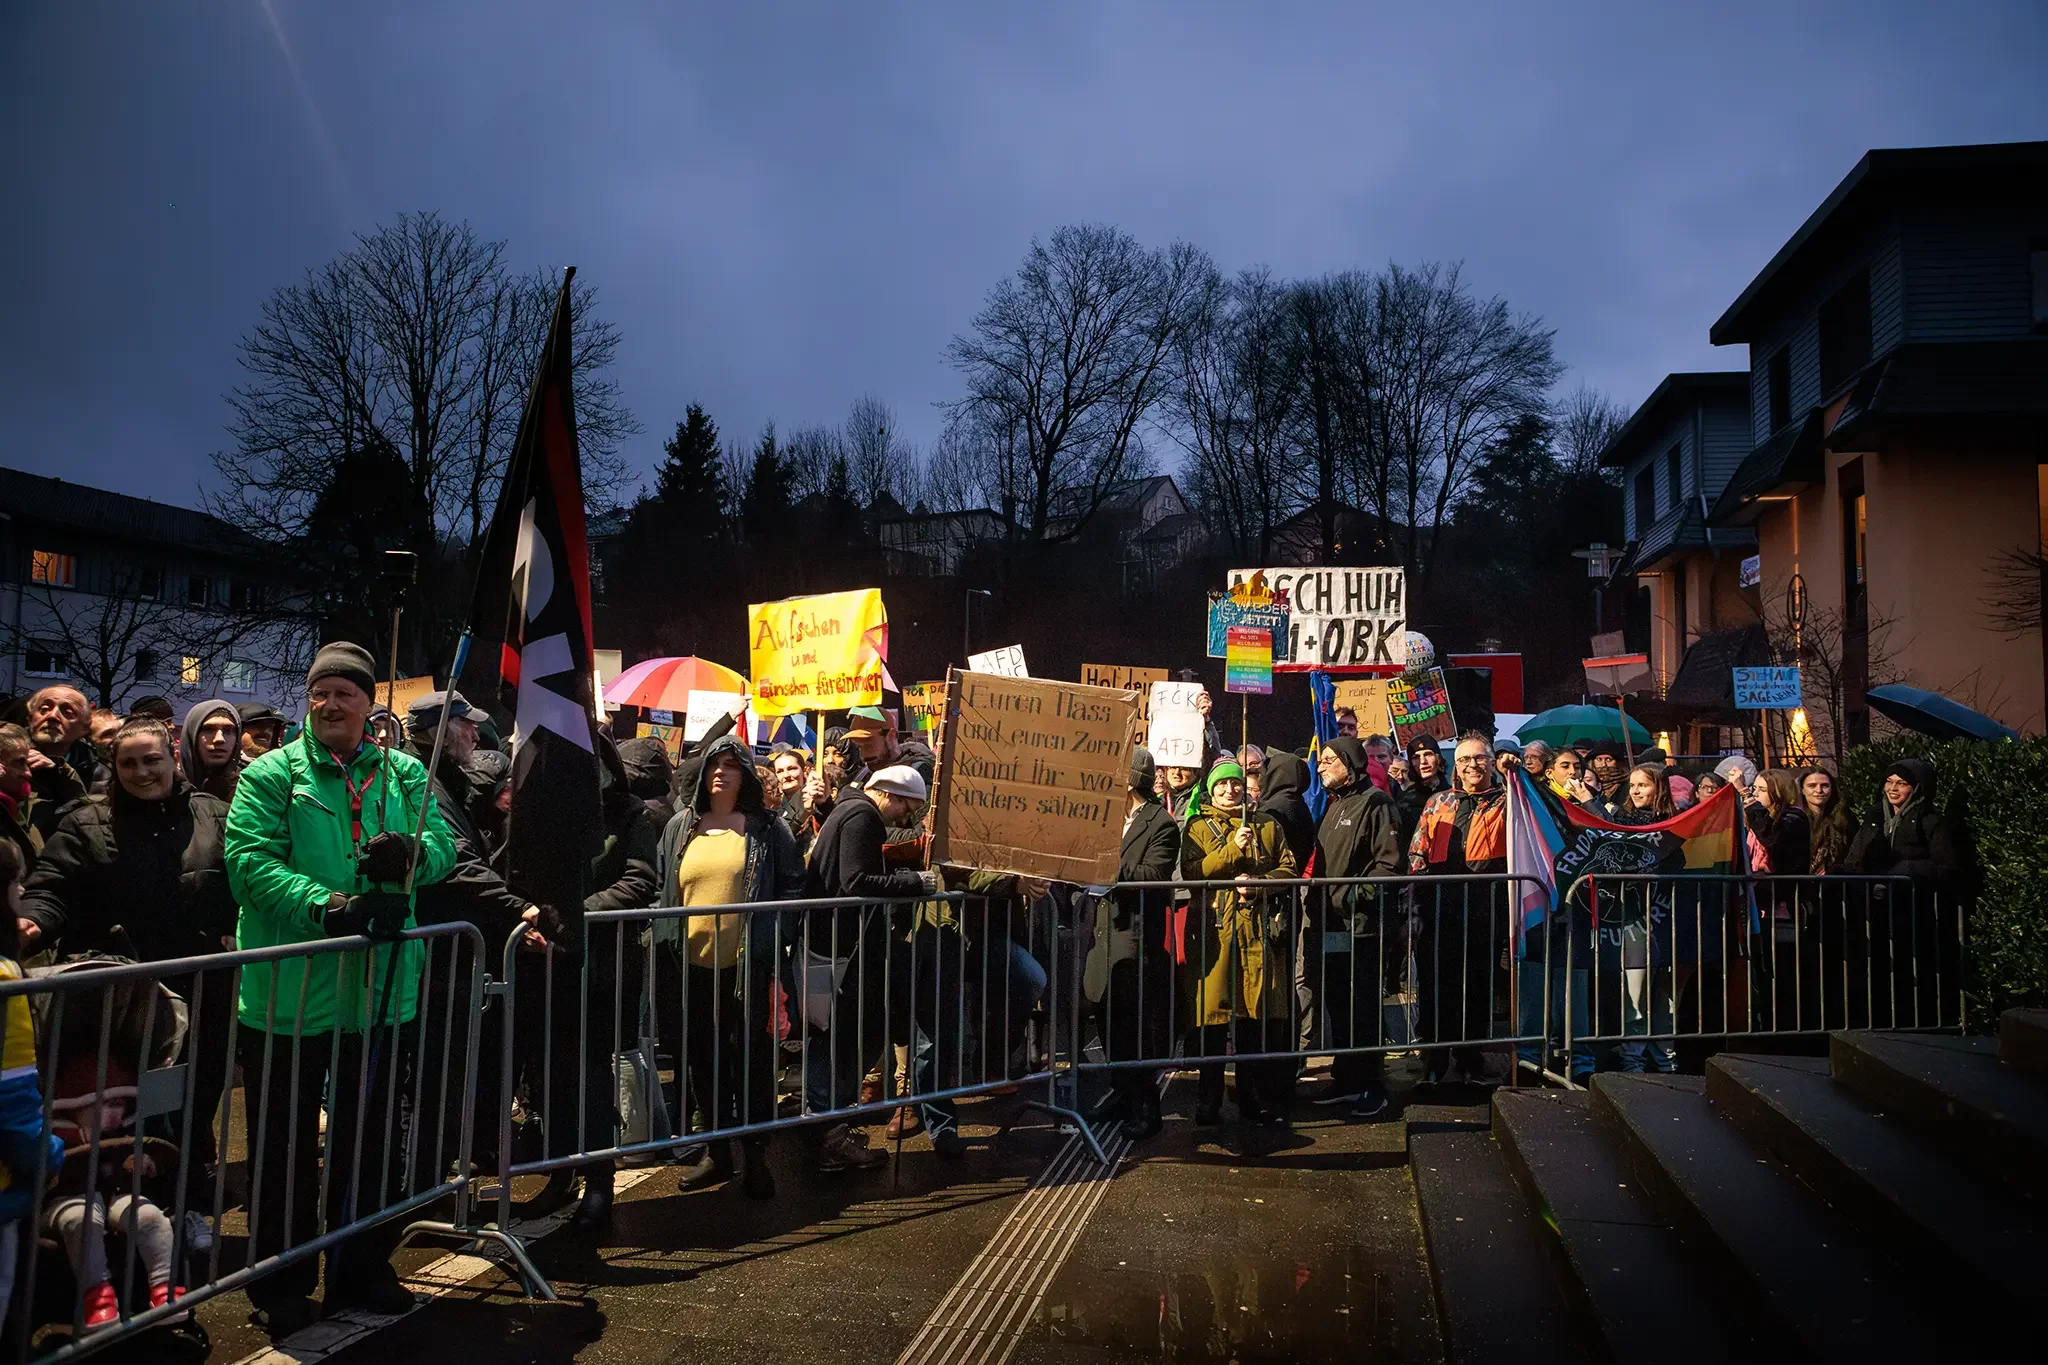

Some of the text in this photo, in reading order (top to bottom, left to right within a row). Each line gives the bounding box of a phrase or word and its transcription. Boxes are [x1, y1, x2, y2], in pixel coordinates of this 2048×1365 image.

[1345, 572, 1403, 613] HUH
[791, 649, 817, 667] und
[980, 646, 1022, 671] AFD
[1157, 688, 1197, 706] FCK
[1348, 684, 1376, 697] reimt
[1390, 688, 1447, 715] BUNT
[1739, 688, 1797, 703] SAGE NEIN
[969, 684, 1042, 714] Euren
[1056, 690, 1111, 723] Hass
[1395, 704, 1447, 726] STATT
[638, 725, 678, 742] NAZI
[963, 720, 1001, 743] und
[1011, 727, 1065, 748] euren
[1071, 730, 1121, 757] Zorn
[1157, 737, 1195, 756] AFD
[958, 751, 1019, 782] könnt
[952, 784, 1027, 812] anders
[1600, 892, 1672, 947] FUTURE
